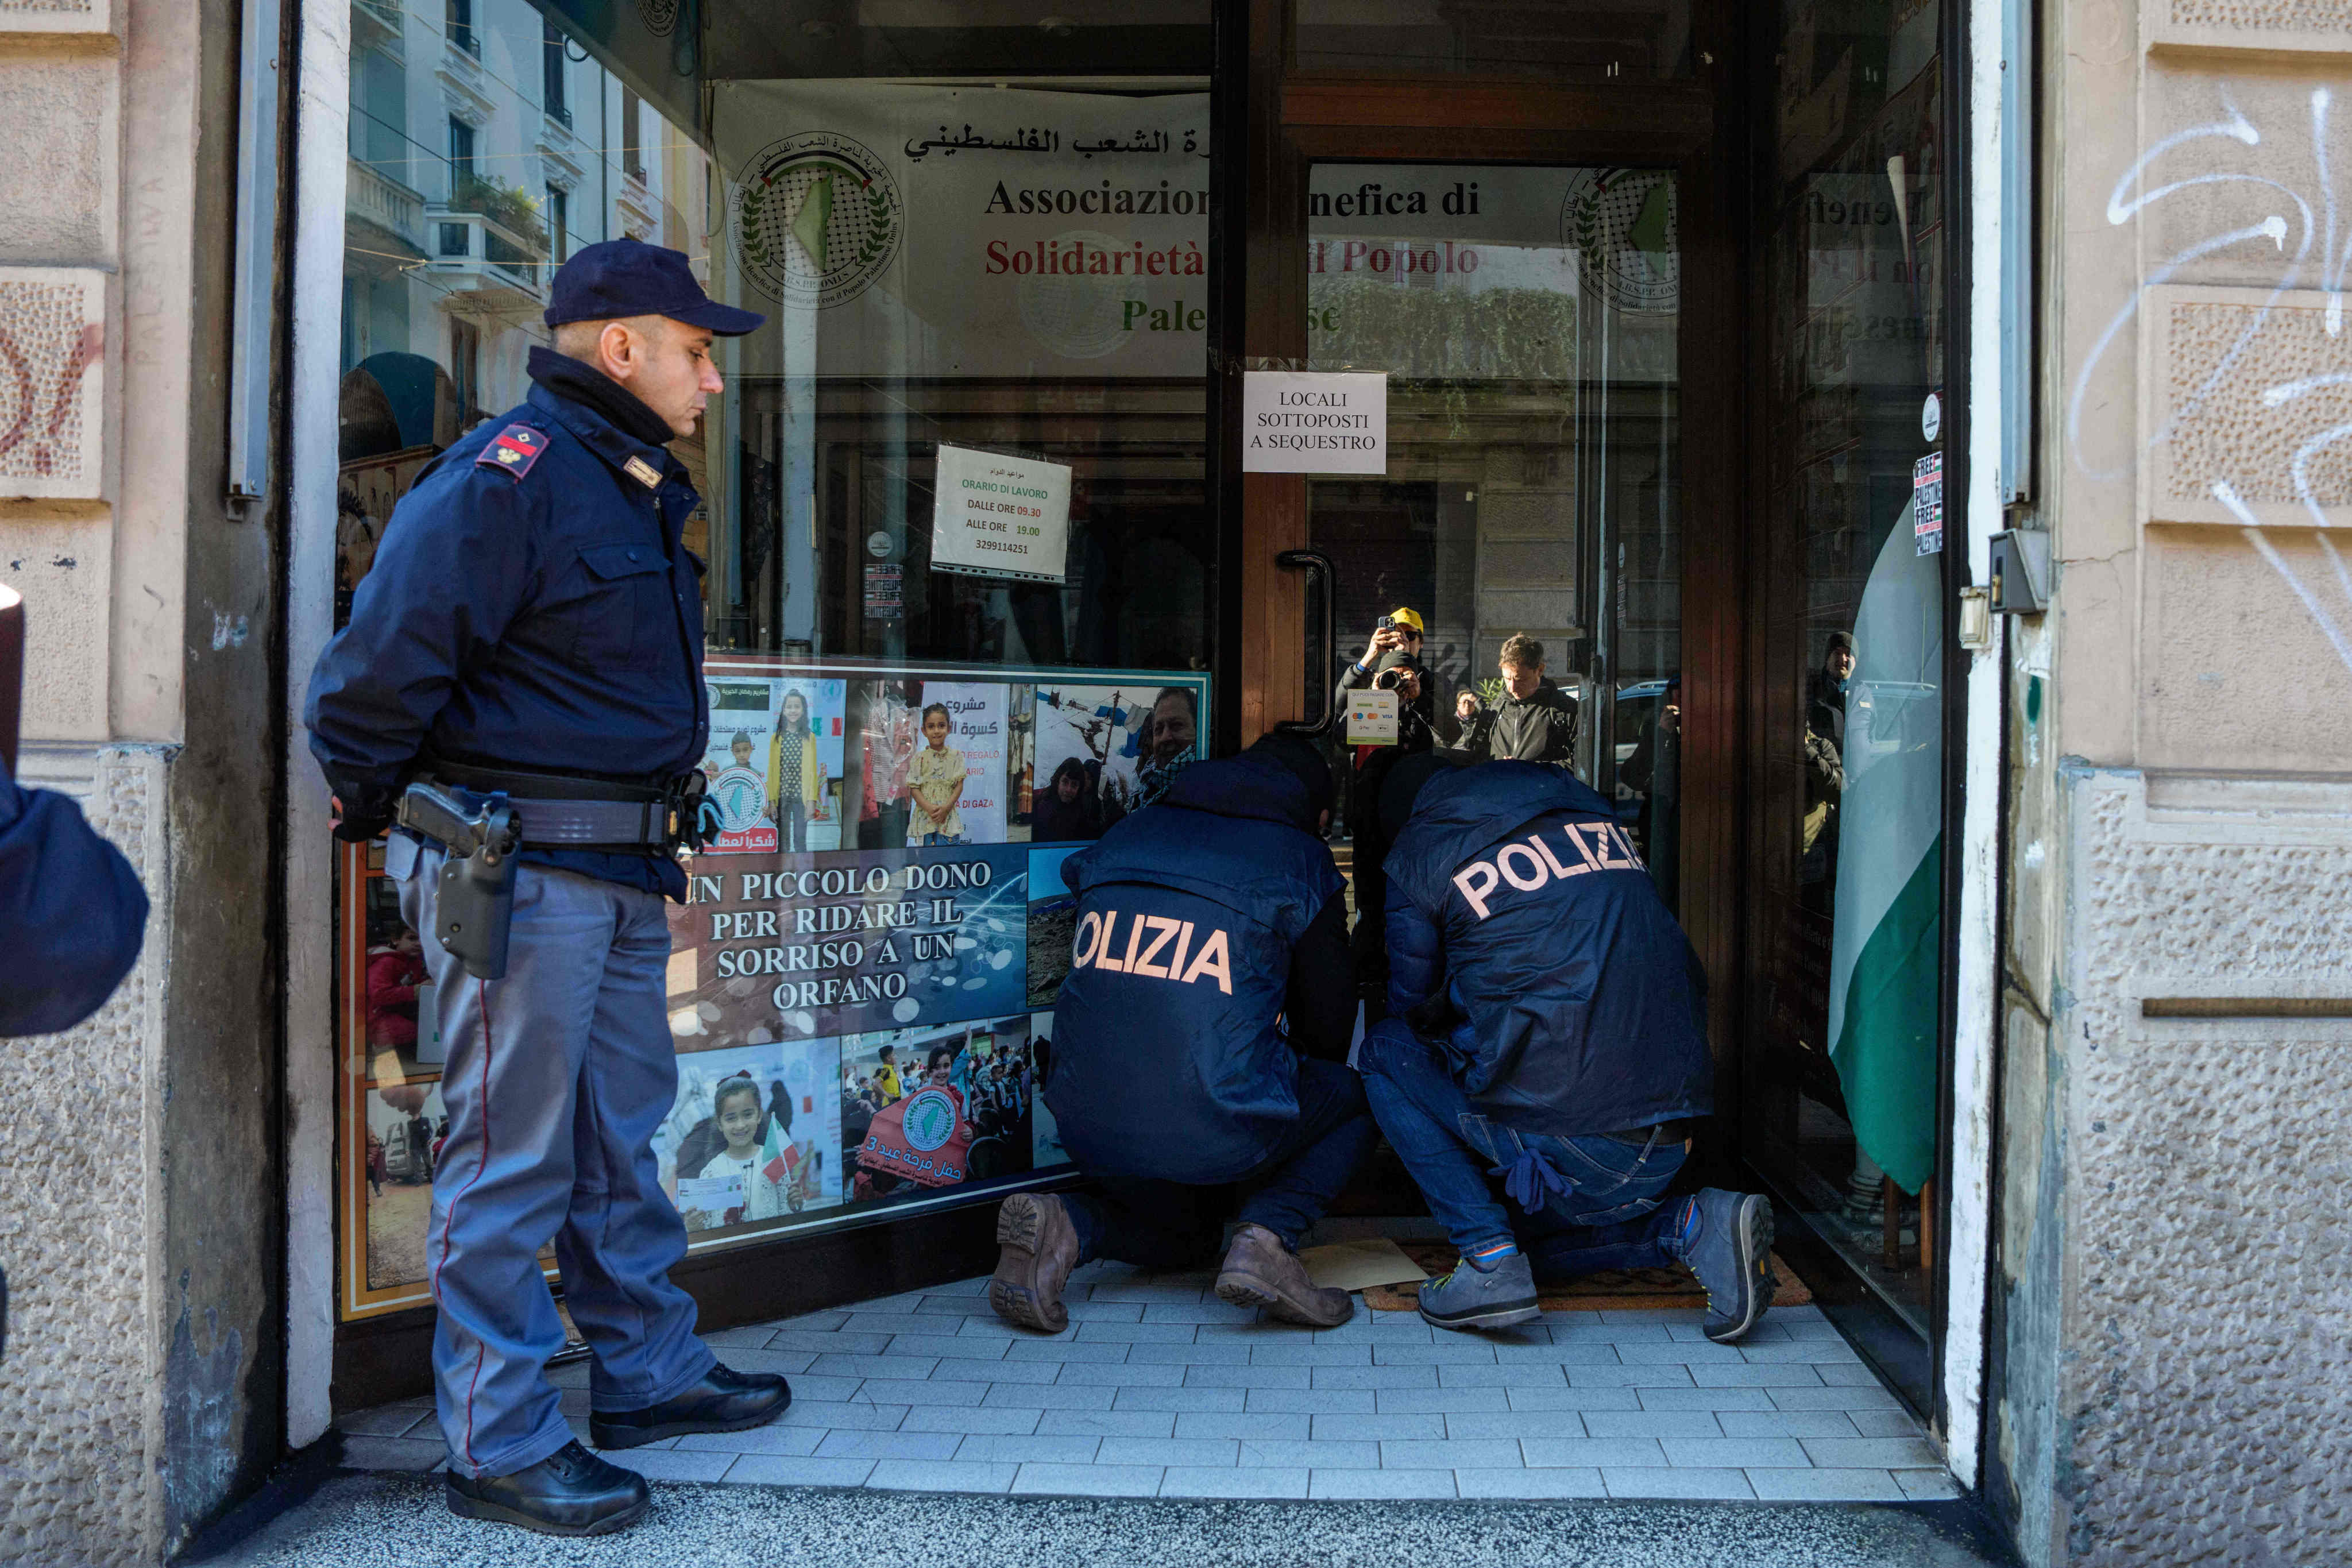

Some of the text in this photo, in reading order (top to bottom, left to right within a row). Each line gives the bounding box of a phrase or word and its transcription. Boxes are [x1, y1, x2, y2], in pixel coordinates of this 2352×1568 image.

[799, 136, 829, 149] الشعب
[904, 123, 1060, 163] الفلسطيني
[1073, 129, 1169, 159] الشعب
[1442, 182, 1480, 215] di
[746, 265, 771, 291] Benefica
[771, 285, 780, 296] di
[822, 295, 836, 304] con
[842, 278, 866, 298] Popolo
[865, 244, 893, 280] Palestinese
[890, 222, 899, 244] Onlus
[986, 241, 1205, 276] Solidarietà
[1341, 241, 1479, 283] Popolo
[1122, 300, 1206, 331] Pale
[1279, 392, 1347, 407] LOCALI
[1258, 413, 1369, 428] SOTTOPOSTI
[1250, 434, 1376, 452] A SEQUESTRO
[962, 479, 1048, 500] ORARIO DI LAVORO
[968, 499, 1041, 517] DALLE ORE 09.30
[1916, 505, 1933, 526] FREE
[966, 519, 1040, 536] ALLE ORE 19.00
[976, 539, 1028, 554] 3299114251
[946, 697, 986, 714] مشروع
[961, 721, 998, 740] كسوة
[967, 750, 999, 759] REGALO
[963, 800, 970, 809] DI
[972, 799, 994, 808] GAZA
[741, 867, 890, 901] PICCOLO
[905, 862, 991, 890] DONO
[710, 898, 963, 940] PER RIDARE IL
[717, 934, 954, 978] SORRISO A UN
[1072, 910, 1233, 995] OLIZIA
[773, 973, 906, 1010] ORFANO
[878, 1144, 901, 1161] عيد
[902, 1149, 933, 1171] فرحة
[933, 1161, 961, 1179] حفل
